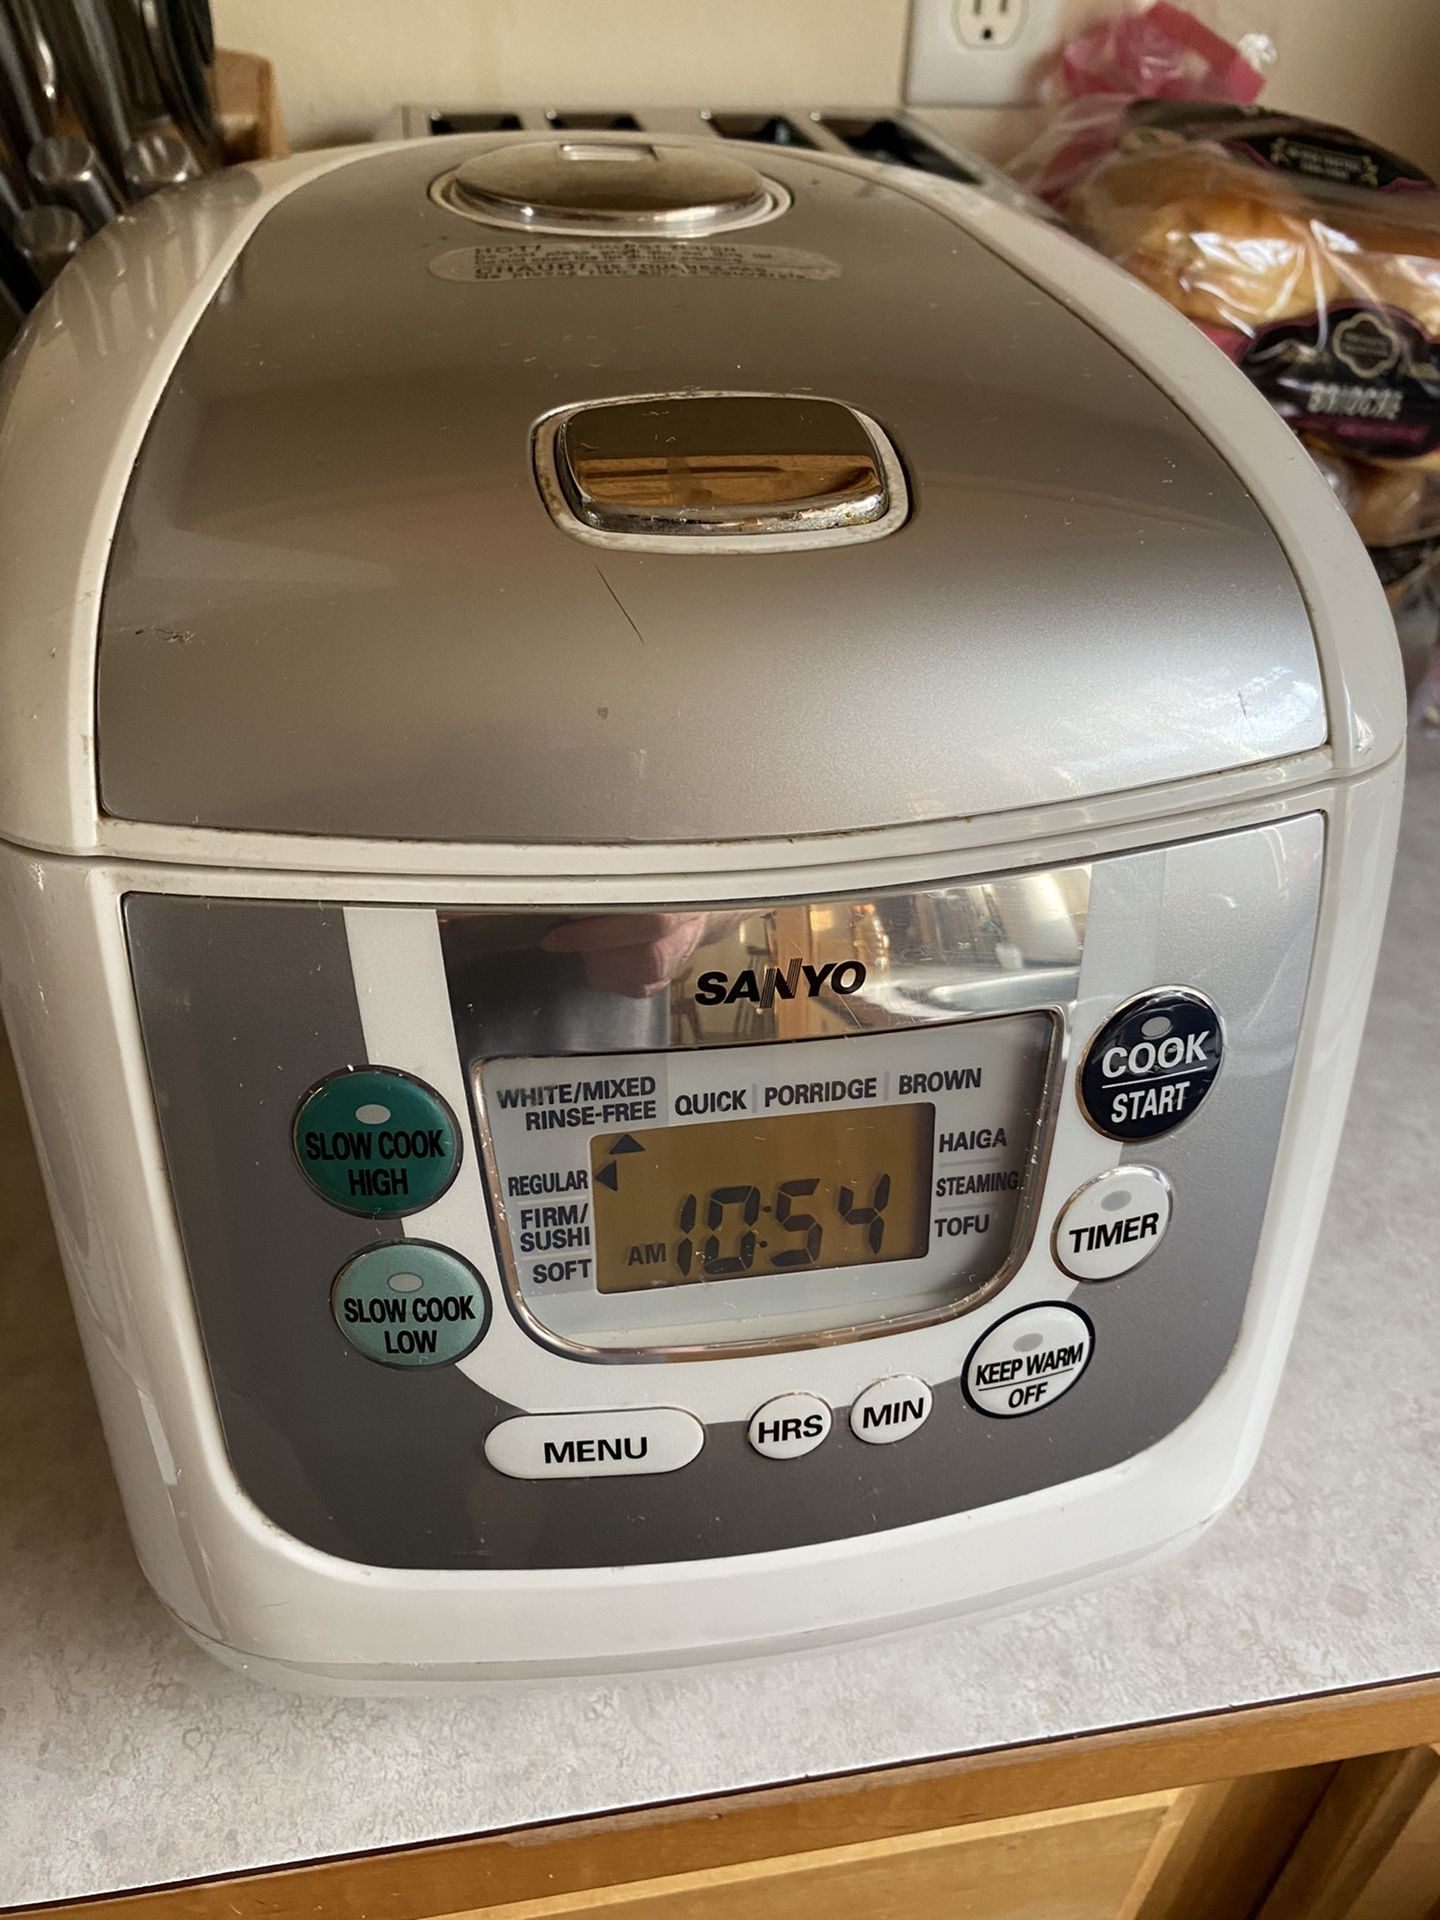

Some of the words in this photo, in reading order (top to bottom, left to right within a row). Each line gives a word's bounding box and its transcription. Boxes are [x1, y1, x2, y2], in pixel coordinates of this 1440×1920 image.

[695, 958, 867, 1010] SANYO
[1101, 1031, 1208, 1079] COOK
[496, 1076, 656, 1110] WHITE/MIXED
[764, 1077, 878, 1108] PORRIDGE
[898, 1067, 982, 1096] BROWN
[525, 1101, 657, 1131] RINSE-FREE
[675, 1090, 747, 1116] QUICK
[1110, 1082, 1190, 1124] START
[305, 1133, 379, 1161] SLOW
[378, 1129, 446, 1160] COOK
[938, 1128, 1008, 1152] HAIGA
[348, 1168, 410, 1197] HIGH
[508, 1170, 589, 1197] REGULAR
[935, 1171, 1020, 1198] STEAMING
[520, 1204, 588, 1230] FIRM/
[627, 1242, 667, 1267] AM
[677, 1173, 891, 1277] 10:54
[934, 1214, 991, 1238] TOFU
[519, 1227, 590, 1253] SUSHI
[1069, 1212, 1160, 1254] TIMER
[532, 1259, 592, 1284] SOFT
[344, 1297, 411, 1324] SLOW
[412, 1295, 476, 1323] COOK
[384, 1330, 438, 1355] LOW
[975, 1358, 1024, 1386] KEEP
[1024, 1343, 1084, 1376] WARM
[1008, 1382, 1048, 1410] OFF
[862, 1397, 925, 1429] MIN
[757, 1414, 824, 1444] HRS
[543, 1437, 649, 1465] MENU
